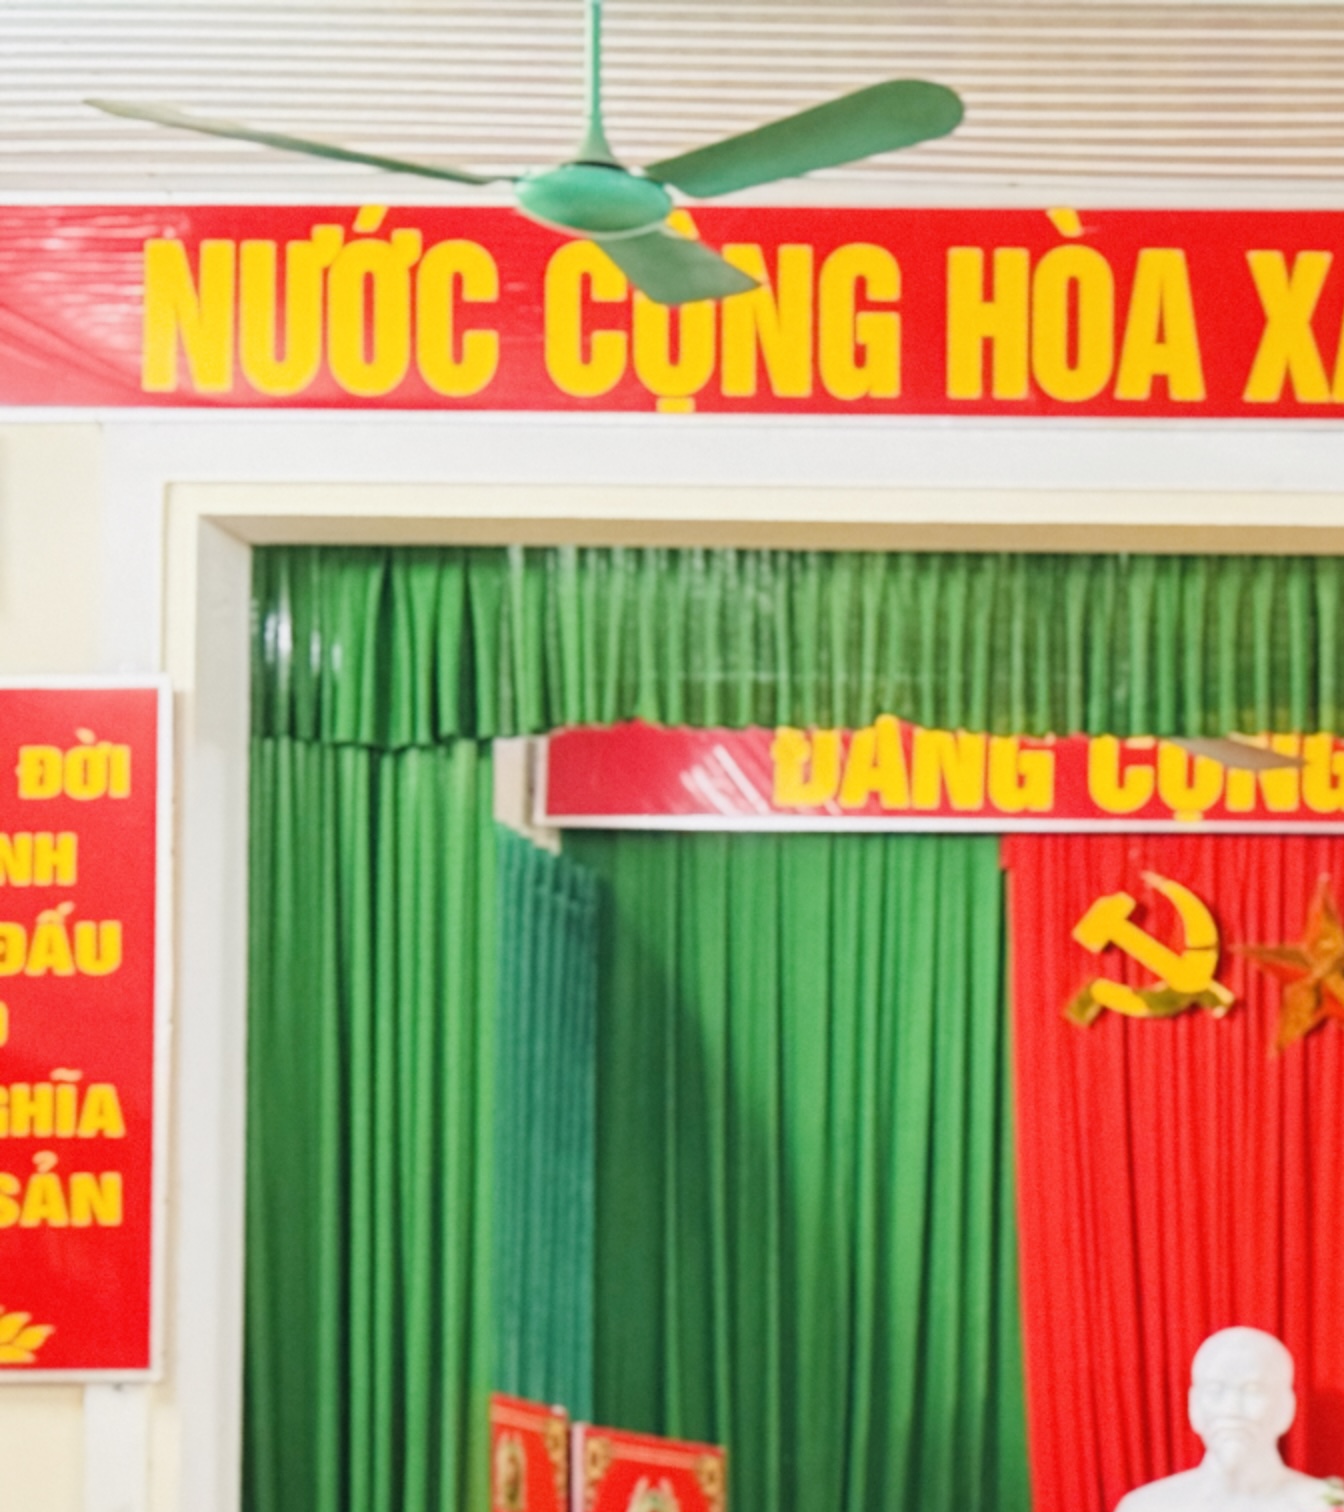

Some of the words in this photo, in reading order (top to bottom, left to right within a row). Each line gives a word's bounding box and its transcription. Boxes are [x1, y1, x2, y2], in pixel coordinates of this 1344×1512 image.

[143, 205, 499, 396] NƯỚC
[946, 207, 1206, 403] HÒA
[14, 727, 132, 800] ĐỜI
[0, 1067, 127, 1140] HĨA
